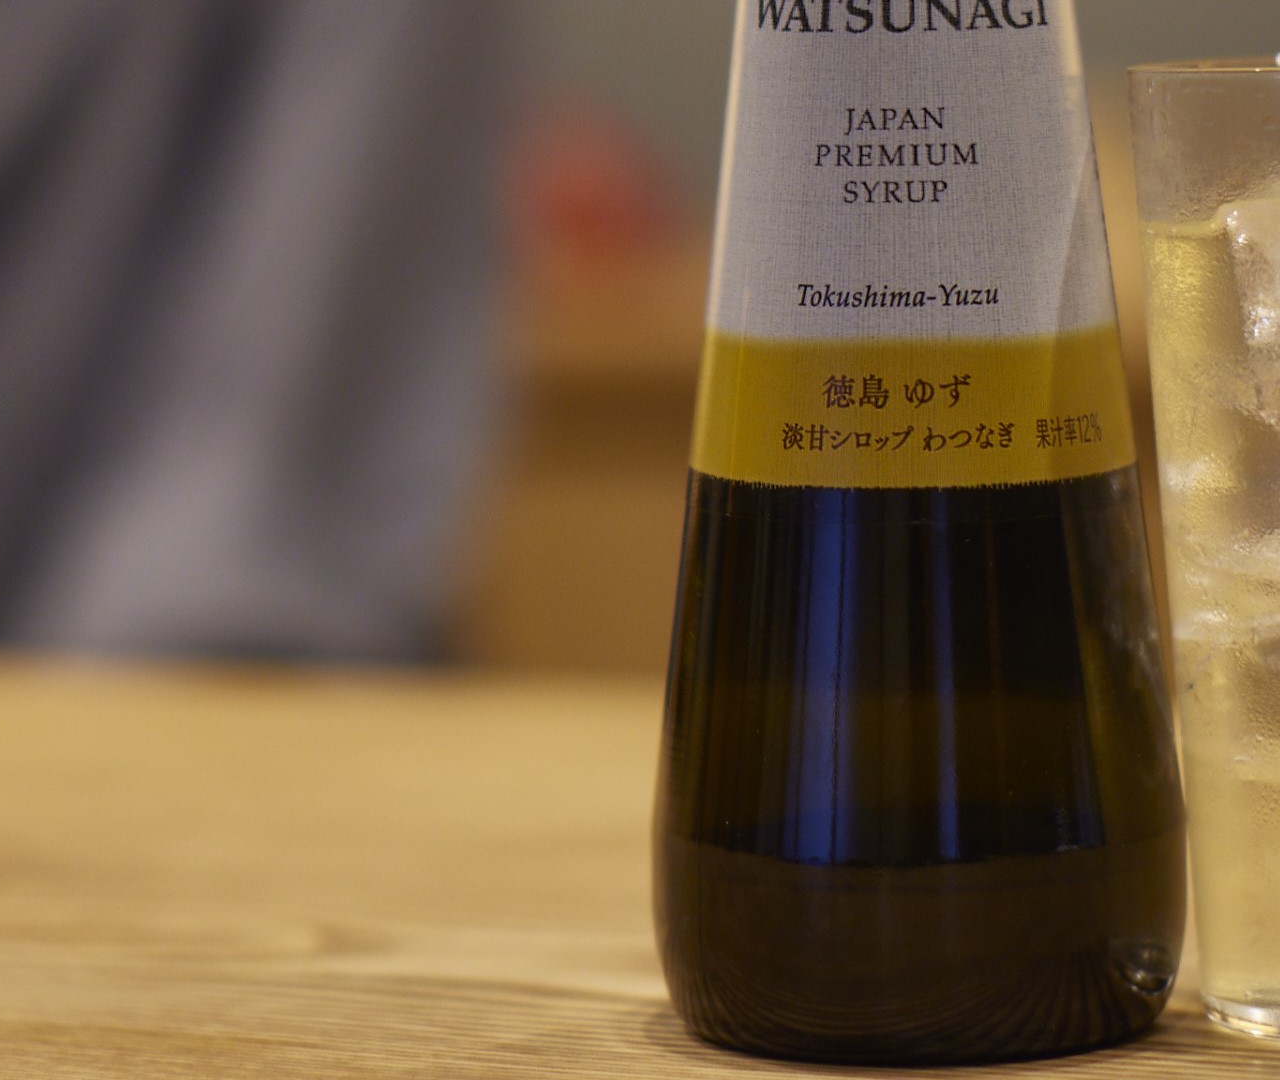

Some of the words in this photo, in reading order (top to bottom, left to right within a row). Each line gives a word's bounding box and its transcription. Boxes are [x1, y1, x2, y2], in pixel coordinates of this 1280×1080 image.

[844, 107, 945, 136] JAPAN
[814, 143, 979, 167] PREMIUM
[843, 180, 948, 204] SYRUP
[797, 284, 1000, 309] Tokushima-Yuzu
[822, 374, 889, 409] 徳島
[903, 374, 971, 408] ゆず
[782, 422, 914, 451] 淡甘シロップ
[922, 422, 1015, 451] わつなぎ
[1035, 412, 1102, 449] 果汁率12%
